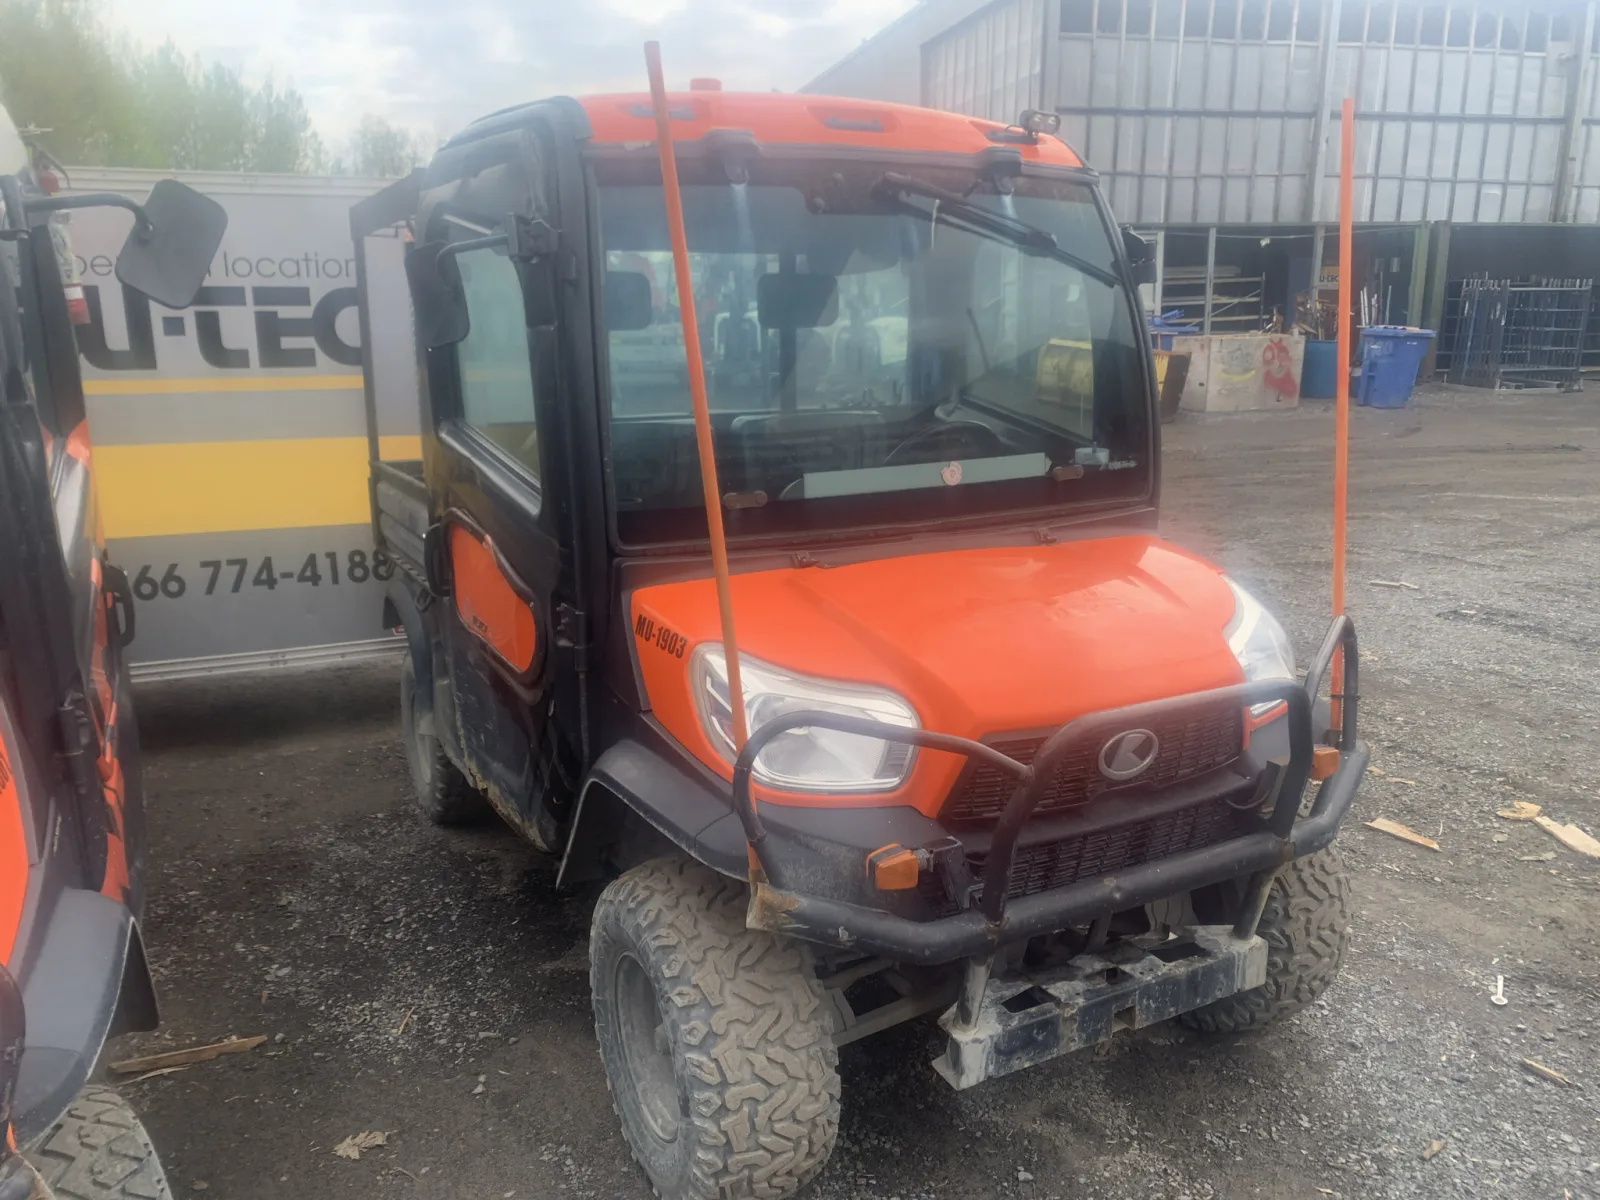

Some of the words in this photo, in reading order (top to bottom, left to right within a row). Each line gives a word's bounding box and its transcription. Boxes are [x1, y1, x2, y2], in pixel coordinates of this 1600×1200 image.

[72, 284, 364, 371] U-TEC
[133, 562, 187, 602] 66
[199, 549, 395, 596] 774-4188
[634, 613, 689, 660] MU-1903
